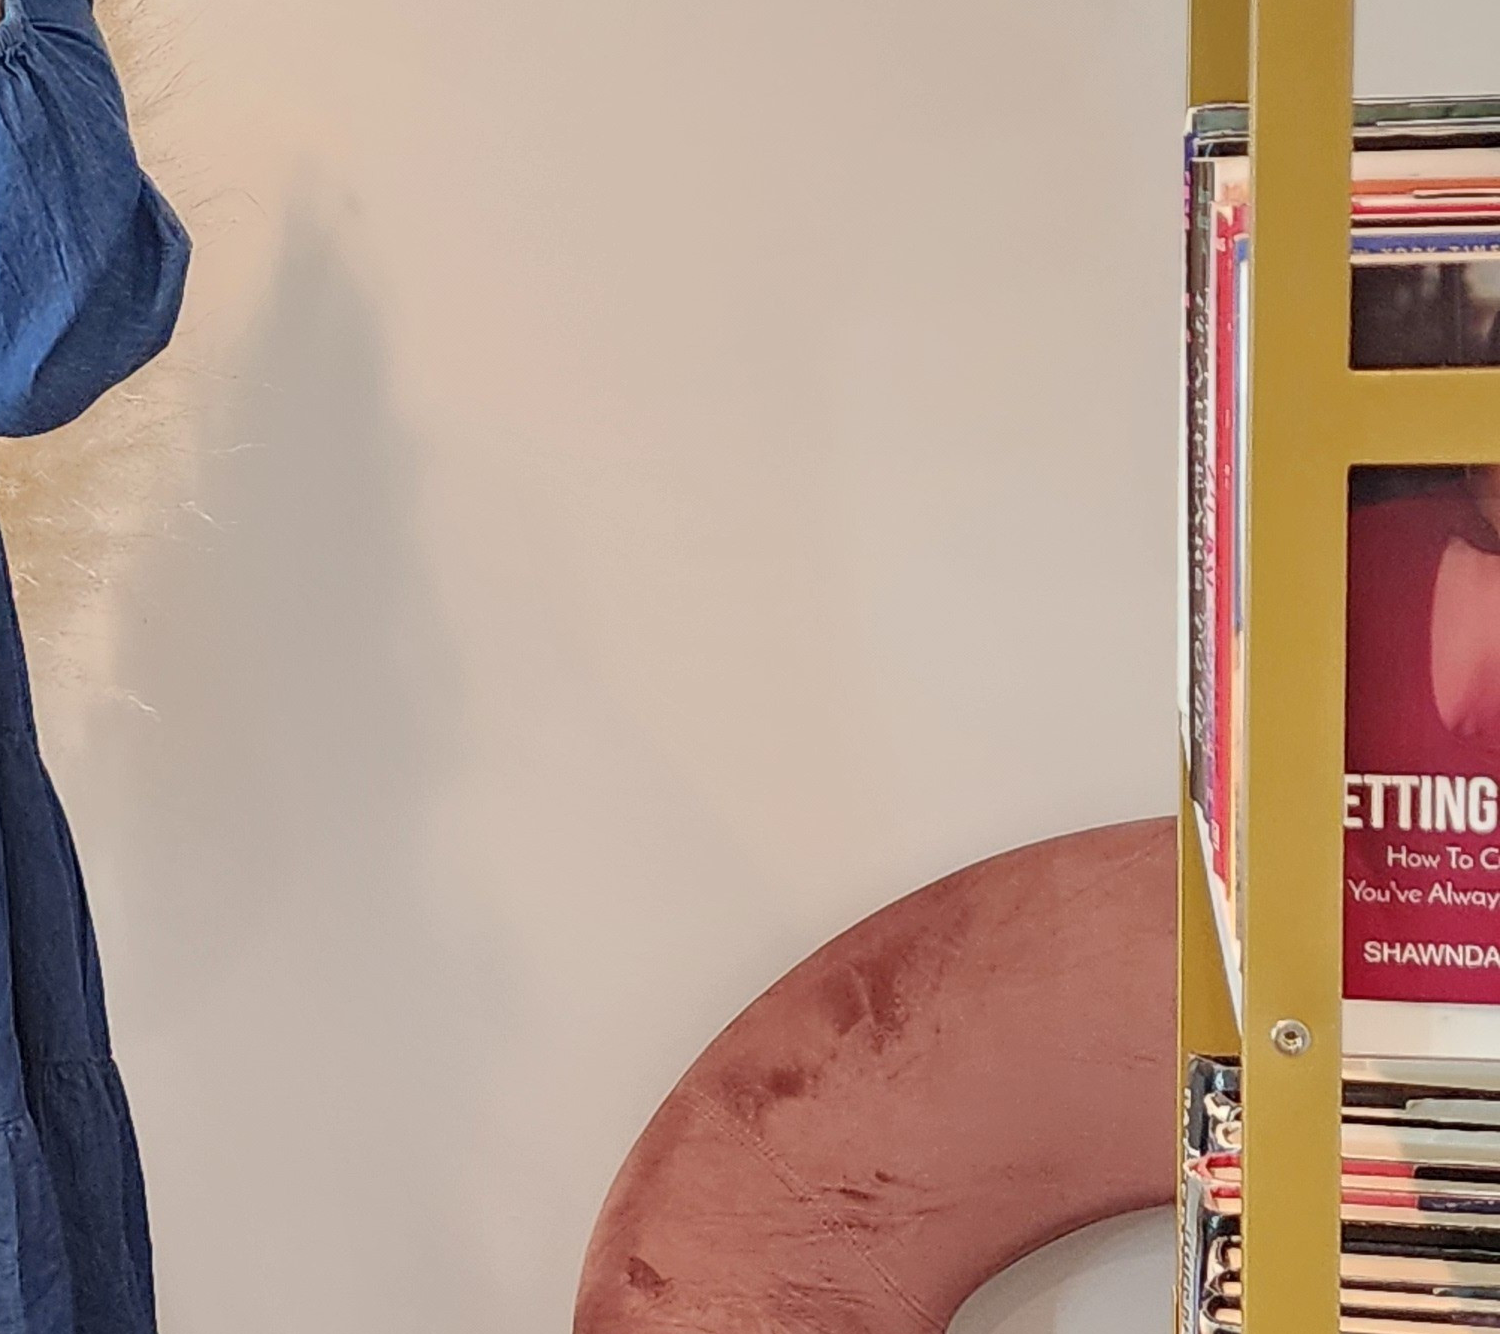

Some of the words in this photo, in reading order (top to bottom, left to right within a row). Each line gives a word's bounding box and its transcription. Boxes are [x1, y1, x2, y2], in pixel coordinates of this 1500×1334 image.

[1343, 773, 1499, 834] ETTING
[1386, 844, 1441, 869] How
[1446, 846, 1474, 870] To
[1347, 878, 1423, 904] You've
[1363, 940, 1500, 969] SHAWNDA
